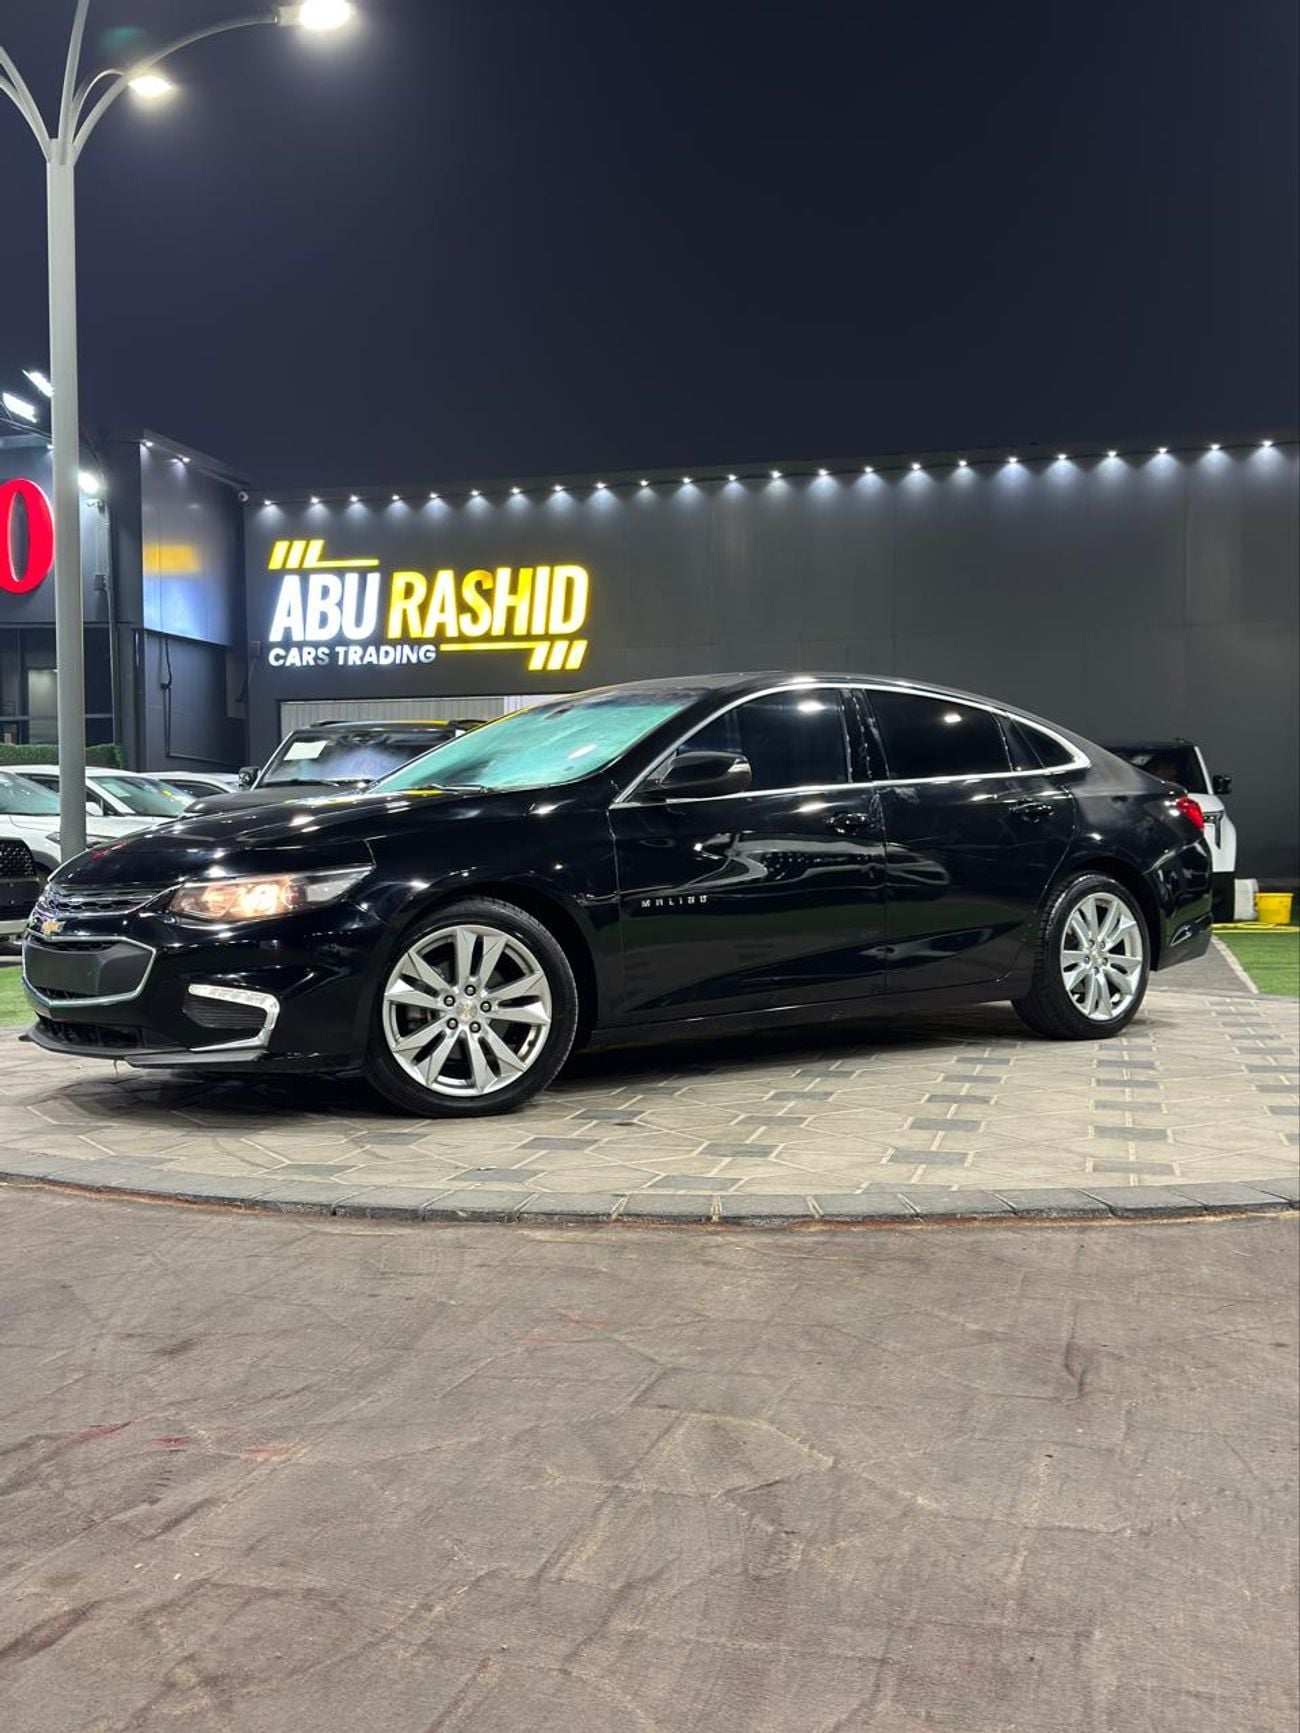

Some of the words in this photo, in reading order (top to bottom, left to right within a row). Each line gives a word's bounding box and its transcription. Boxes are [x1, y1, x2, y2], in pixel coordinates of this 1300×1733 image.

[269, 572, 380, 642] ABU
[387, 565, 589, 639] RASHID
[268, 647, 330, 667] CARS
[335, 644, 437, 666] TRADING
[641, 895, 707, 907] MALIBU
